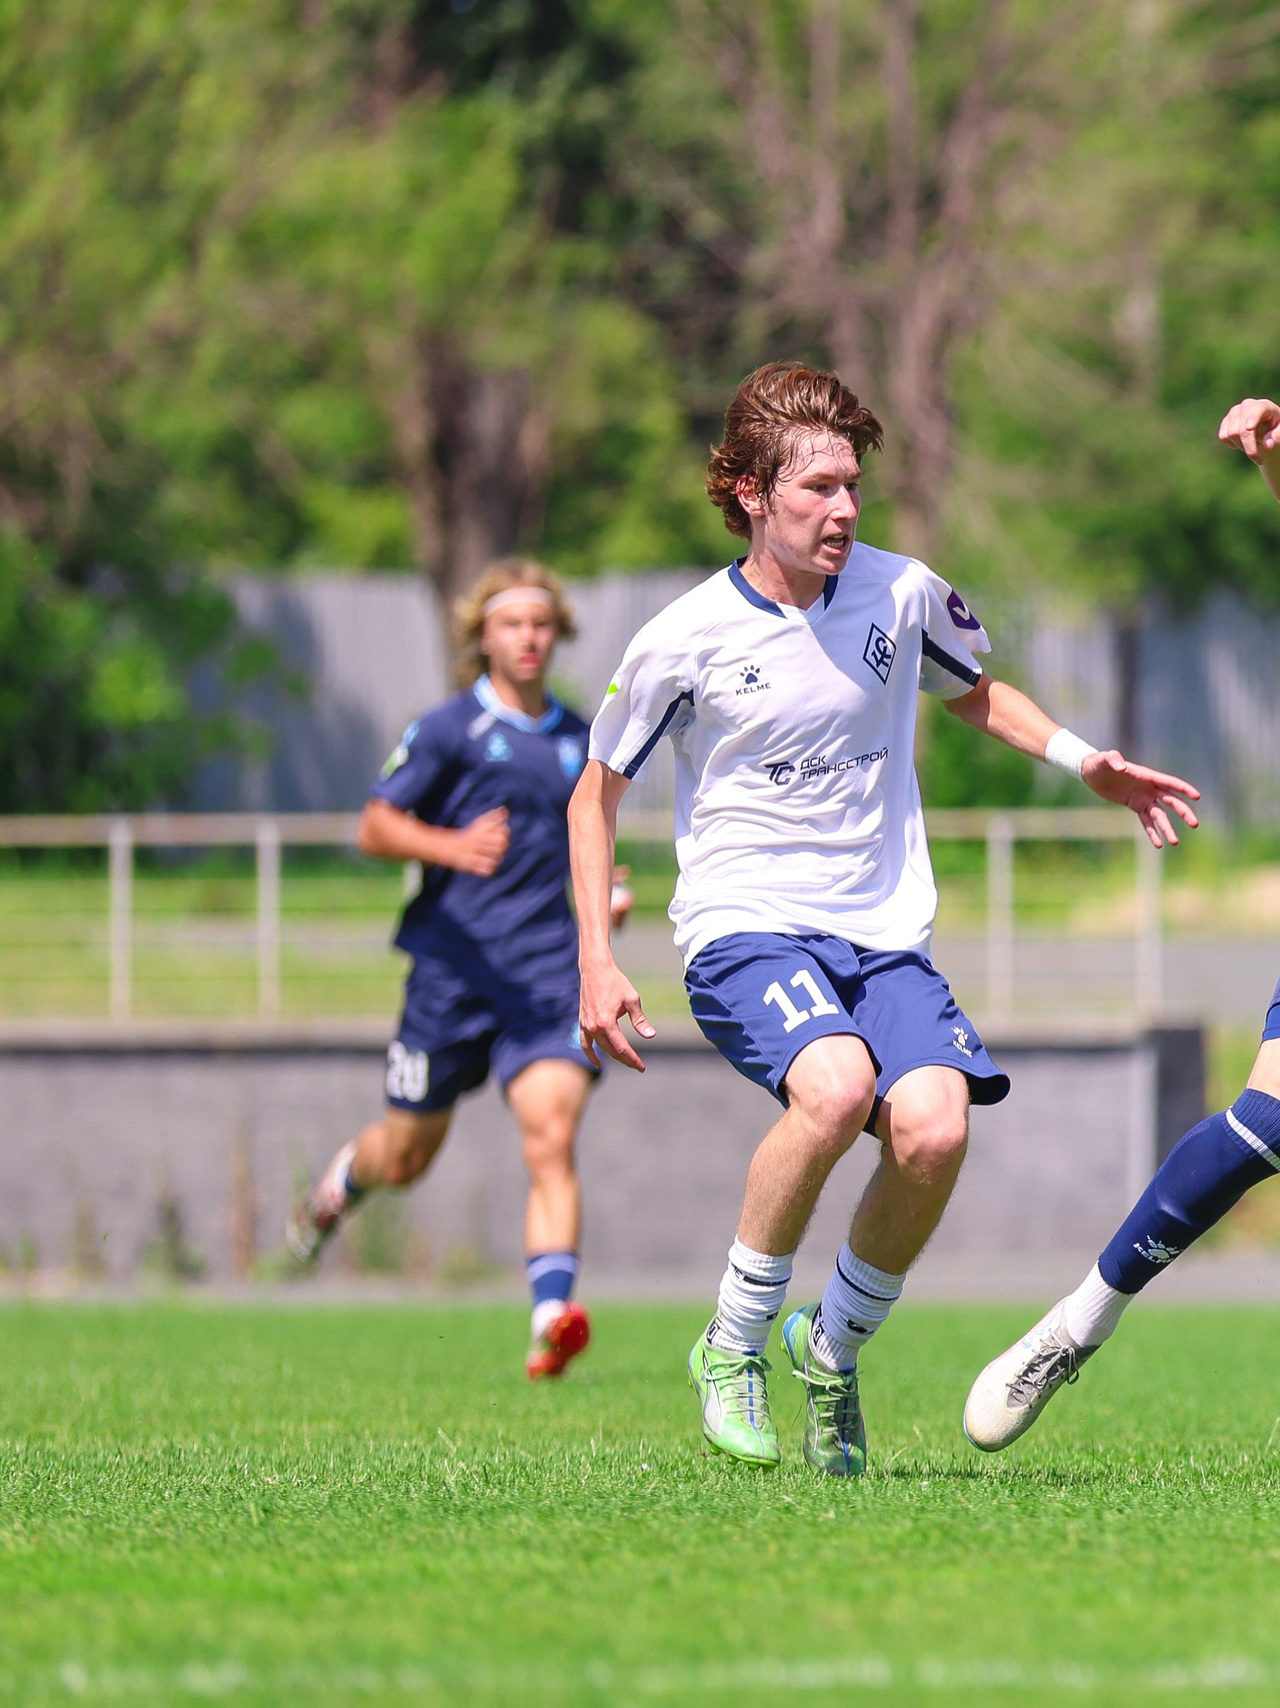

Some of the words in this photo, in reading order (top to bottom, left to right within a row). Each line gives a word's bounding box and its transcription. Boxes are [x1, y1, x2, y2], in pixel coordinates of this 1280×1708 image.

[735, 682, 772, 696] KELME
[800, 755, 826, 771] ДСК
[801, 746, 889, 781] ТРАНССТРОЙ
[763, 969, 839, 1034] 11
